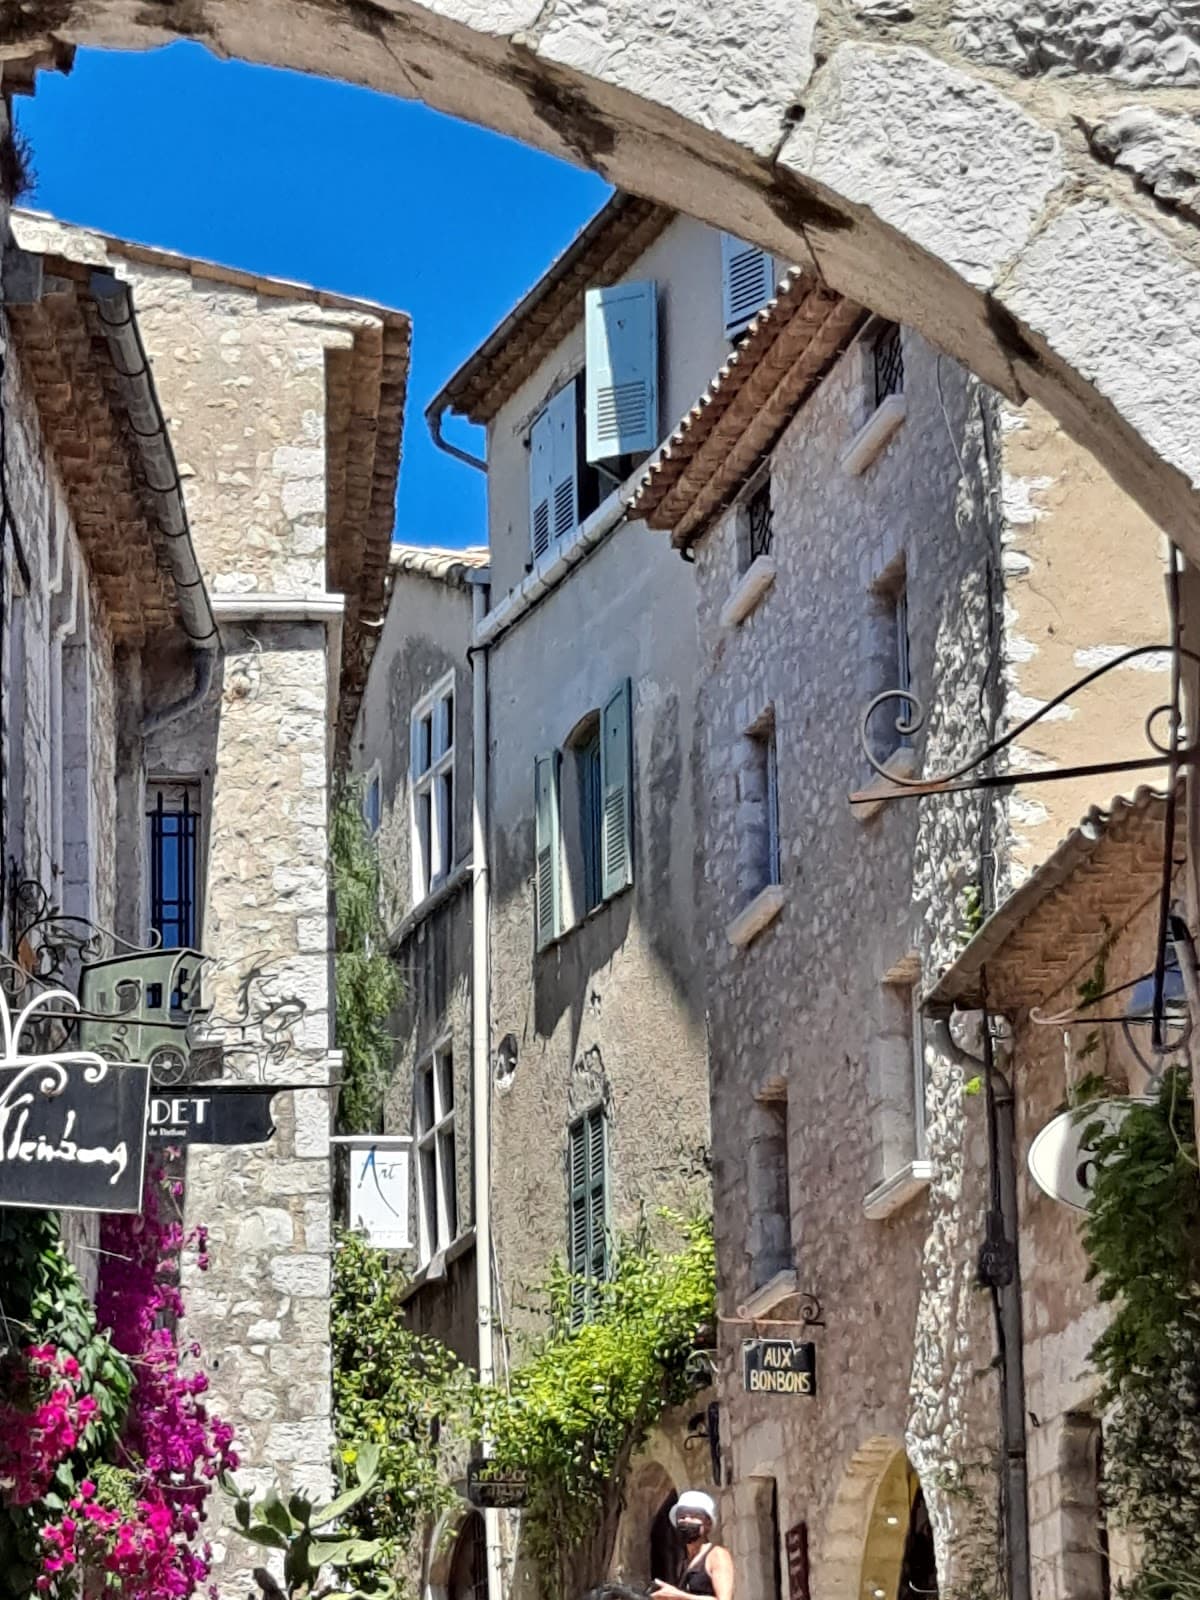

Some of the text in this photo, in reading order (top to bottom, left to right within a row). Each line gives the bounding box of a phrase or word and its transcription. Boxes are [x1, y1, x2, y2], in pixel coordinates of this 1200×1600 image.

[357, 1145, 403, 1218] Art
[763, 1347, 792, 1368] AUX
[750, 1369, 811, 1393] BONBONS
